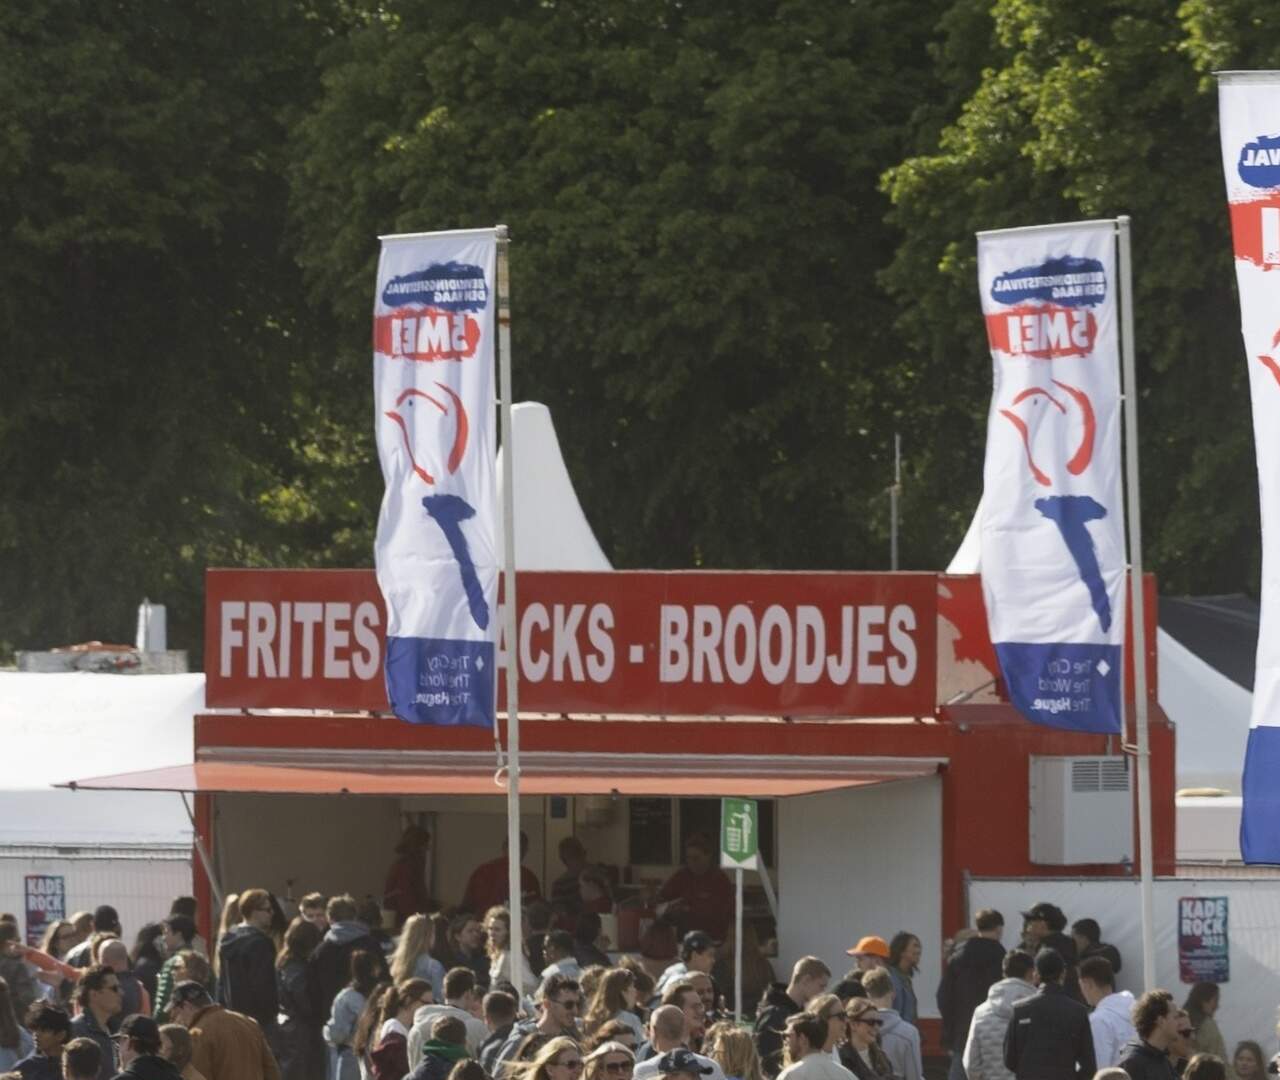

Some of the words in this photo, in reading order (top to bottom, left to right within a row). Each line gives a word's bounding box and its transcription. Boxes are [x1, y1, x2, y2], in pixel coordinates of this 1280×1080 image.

[221, 601, 380, 679] FRITES
[660, 604, 918, 685] BROODJES
[27, 878, 64, 894] KADE
[28, 895, 63, 911] ROCK
[1181, 900, 1226, 918] KADE
[1182, 918, 1225, 936] ROCK
